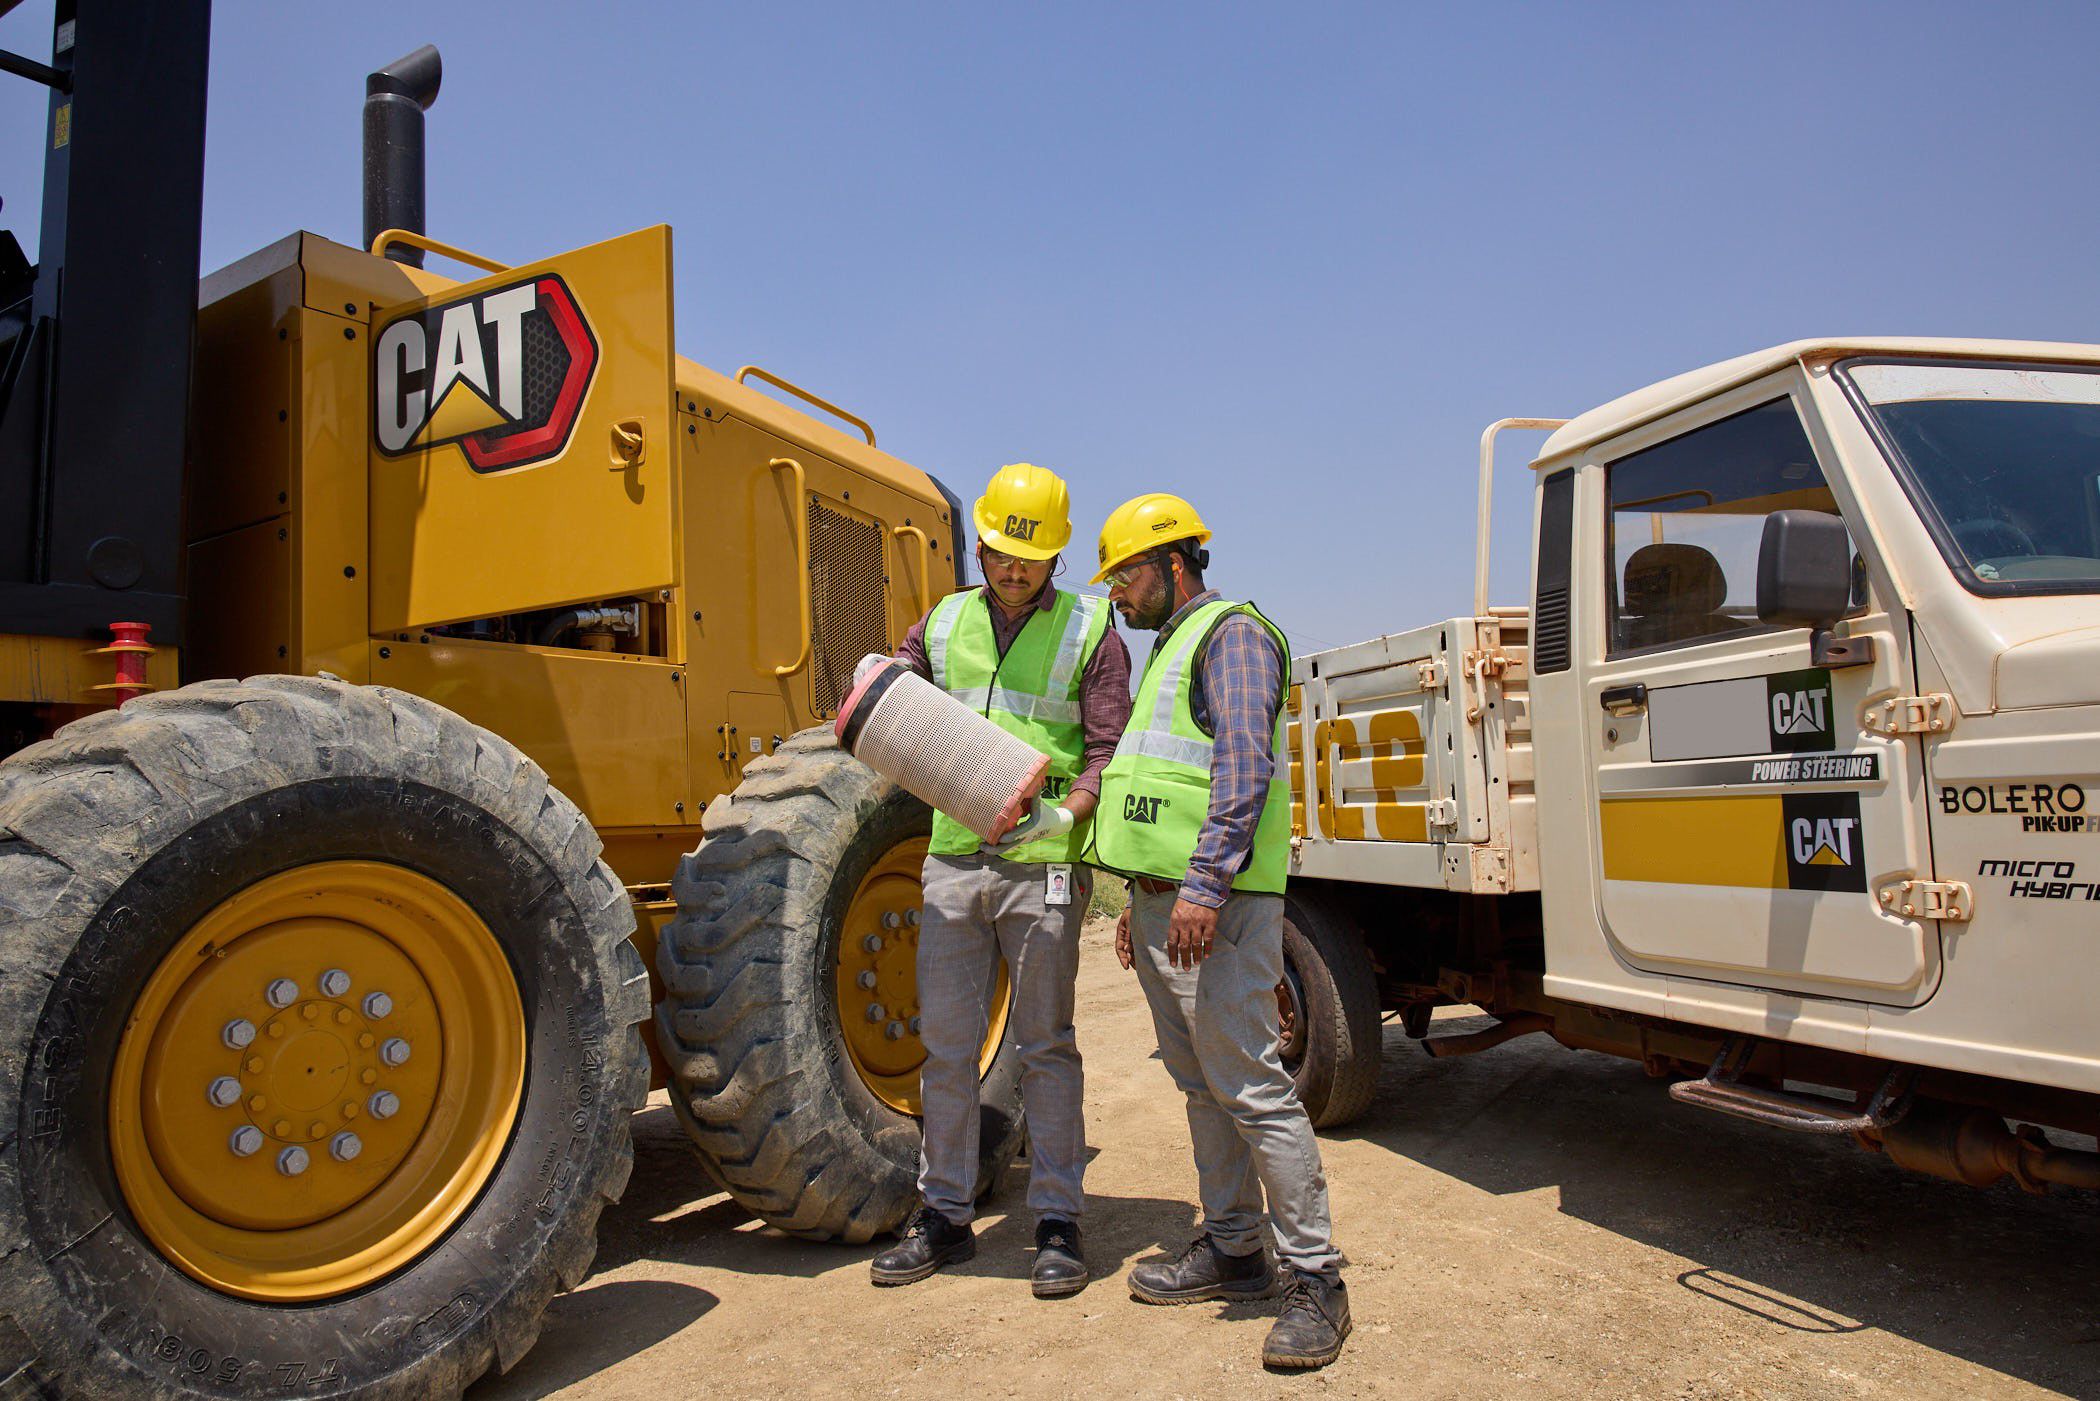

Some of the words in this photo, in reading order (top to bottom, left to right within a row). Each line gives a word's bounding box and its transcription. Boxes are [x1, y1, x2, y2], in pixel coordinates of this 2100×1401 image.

[378, 283, 535, 450] CAT
[1005, 514, 1039, 541] CAT
[1773, 688, 1827, 734] CAT
[1752, 761, 1800, 780] POWER
[1802, 757, 1872, 779] STEERING
[1041, 776, 1065, 799] AT
[1939, 784, 2085, 814] BOLERO
[2023, 816, 2084, 832] PIK-UP
[1792, 817, 1854, 865] CAT
[157, 1334, 242, 1384] 508
